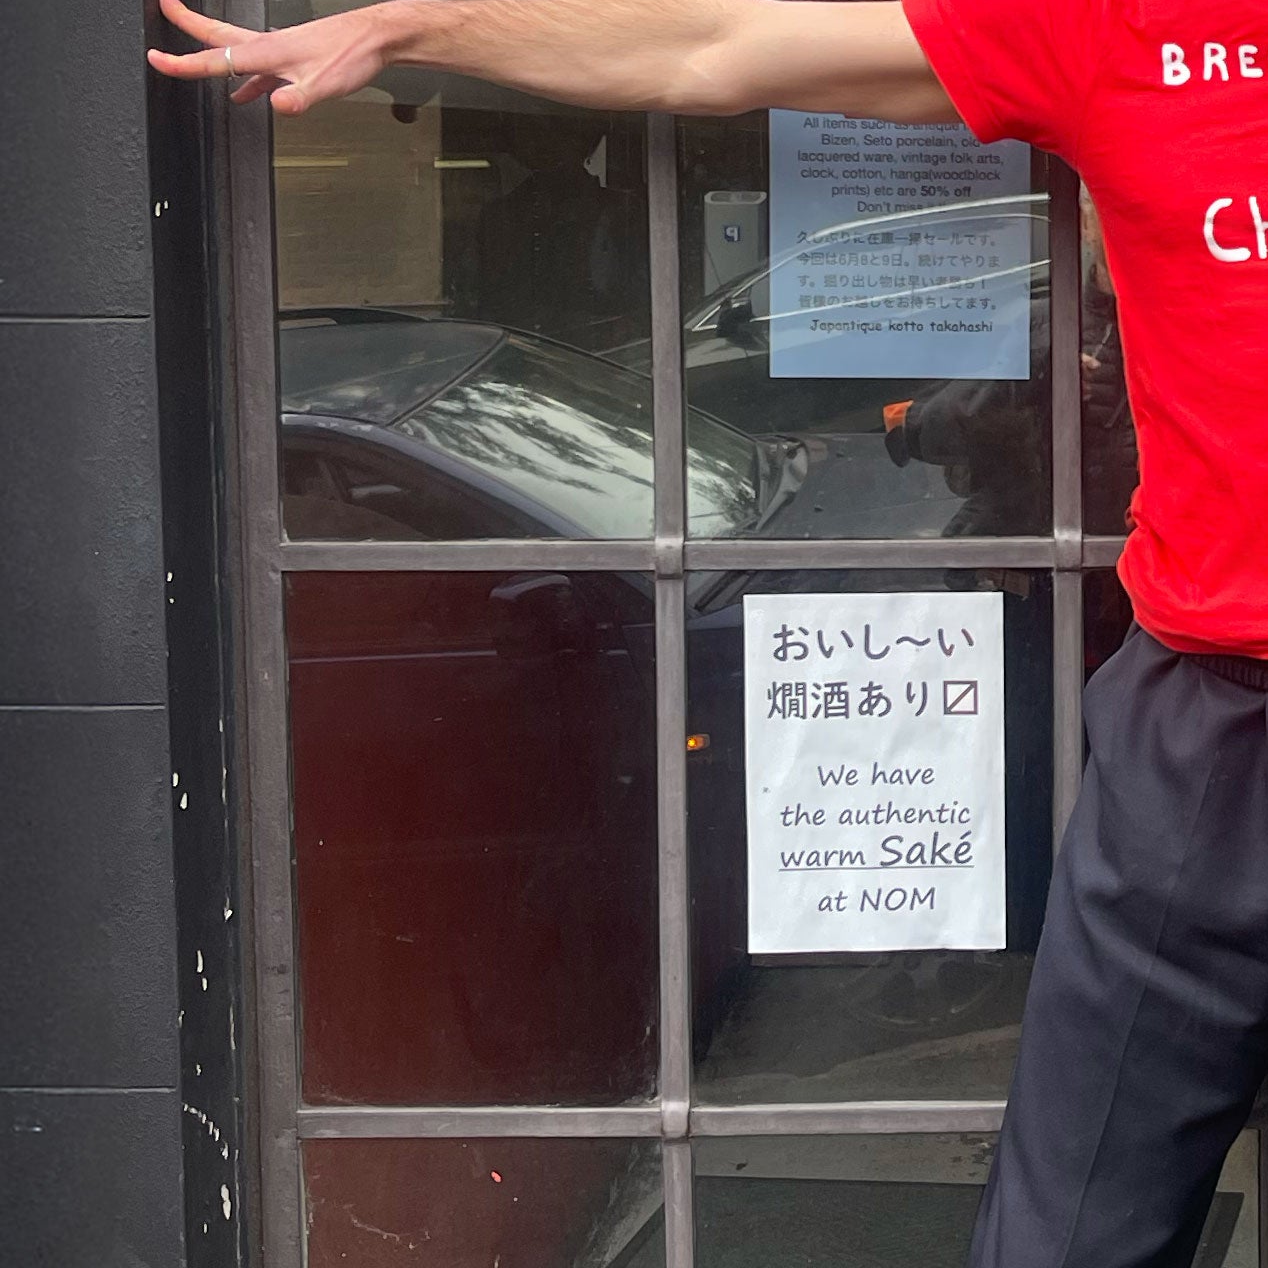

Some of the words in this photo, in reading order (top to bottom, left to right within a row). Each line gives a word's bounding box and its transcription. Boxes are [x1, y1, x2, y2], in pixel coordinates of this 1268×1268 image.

[803, 118, 820, 130] All
[823, 118, 857, 130] items
[821, 135, 858, 147] Bizen,
[864, 135, 892, 147] Seto
[897, 135, 956, 148] porcelain,
[798, 151, 860, 165] lacquered
[864, 153, 896, 164] ware,
[902, 152, 946, 166] vintage
[950, 152, 973, 164] folk
[977, 153, 1003, 166] arts,
[801, 169, 836, 180] clock,
[843, 169, 885, 181] cotton,
[831, 185, 870, 198] prints)
[874, 186, 893, 196] etc
[897, 187, 916, 196] are
[921, 185, 949, 197] 50%
[954, 185, 972, 197] off
[857, 202, 891, 213] Don't
[888, 320, 924, 332] kotto
[930, 321, 992, 332] takahashi
[817, 765, 858, 786] We
[872, 762, 935, 786] have
[781, 804, 826, 826] the
[838, 801, 970, 824] authentic
[781, 850, 865, 867] warm
[880, 830, 974, 868] Saké
[818, 890, 848, 912] at
[860, 887, 935, 911] NOM
